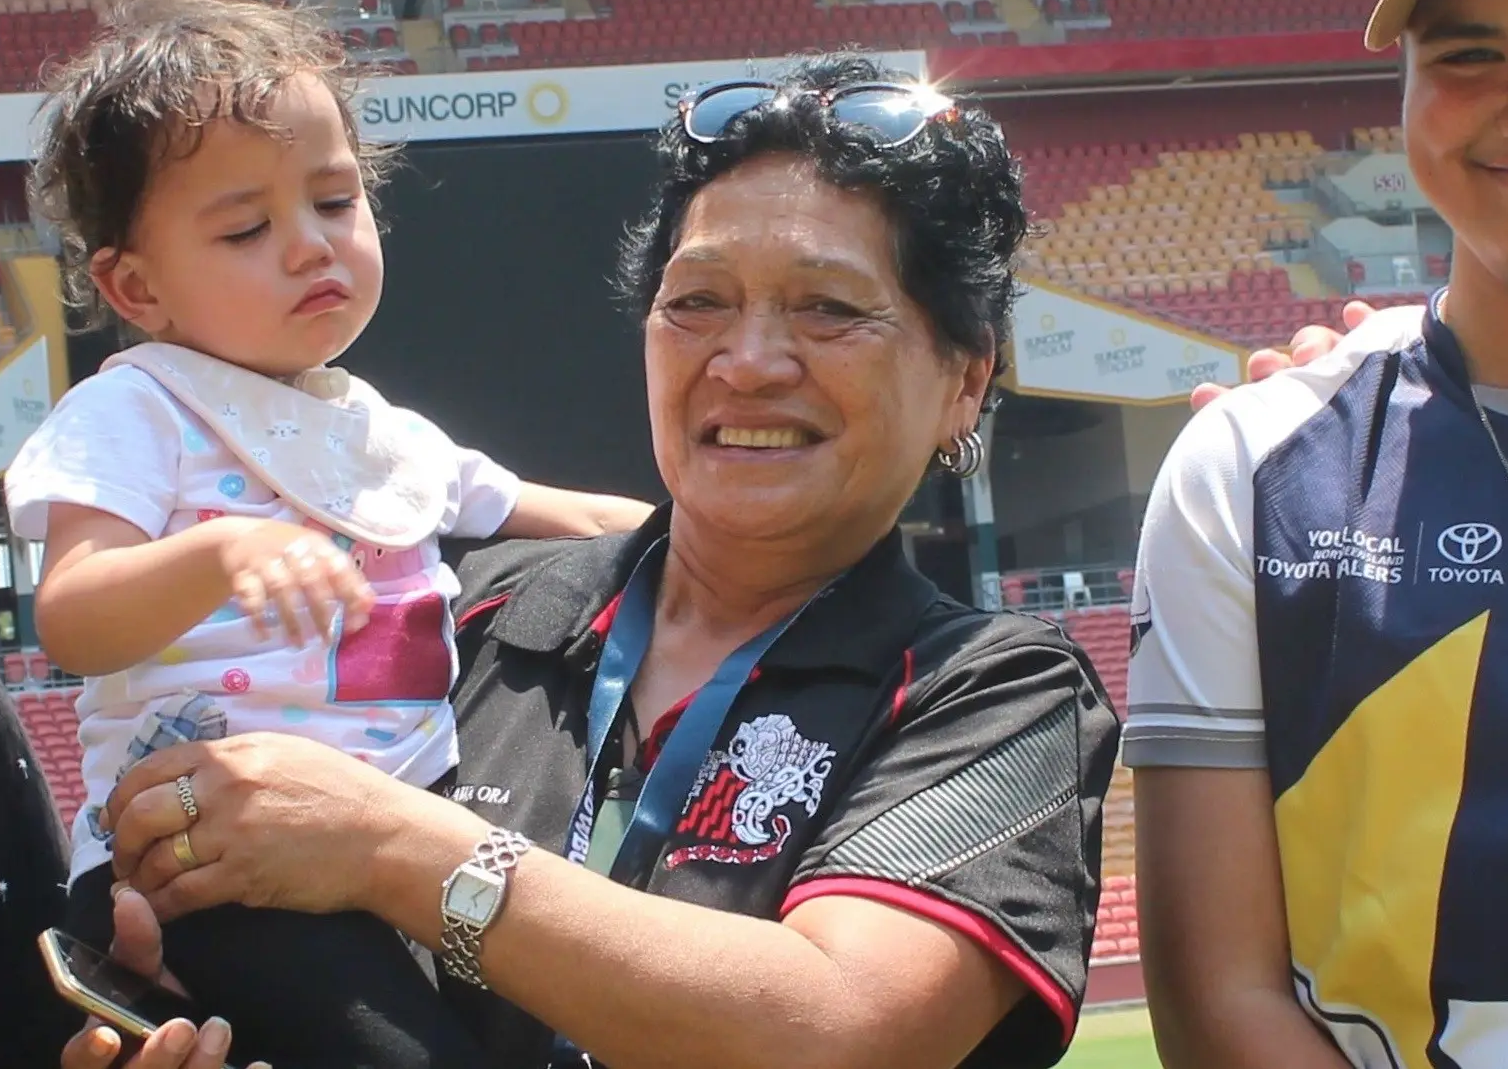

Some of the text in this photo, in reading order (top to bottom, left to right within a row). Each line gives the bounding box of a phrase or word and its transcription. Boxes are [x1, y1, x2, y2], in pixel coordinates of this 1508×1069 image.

[363, 91, 517, 125] SUNCORP
[1257, 555, 1330, 580] TOYOTA
[1428, 567, 1505, 584] TOYOTA
[477, 785, 510, 804] ORA
